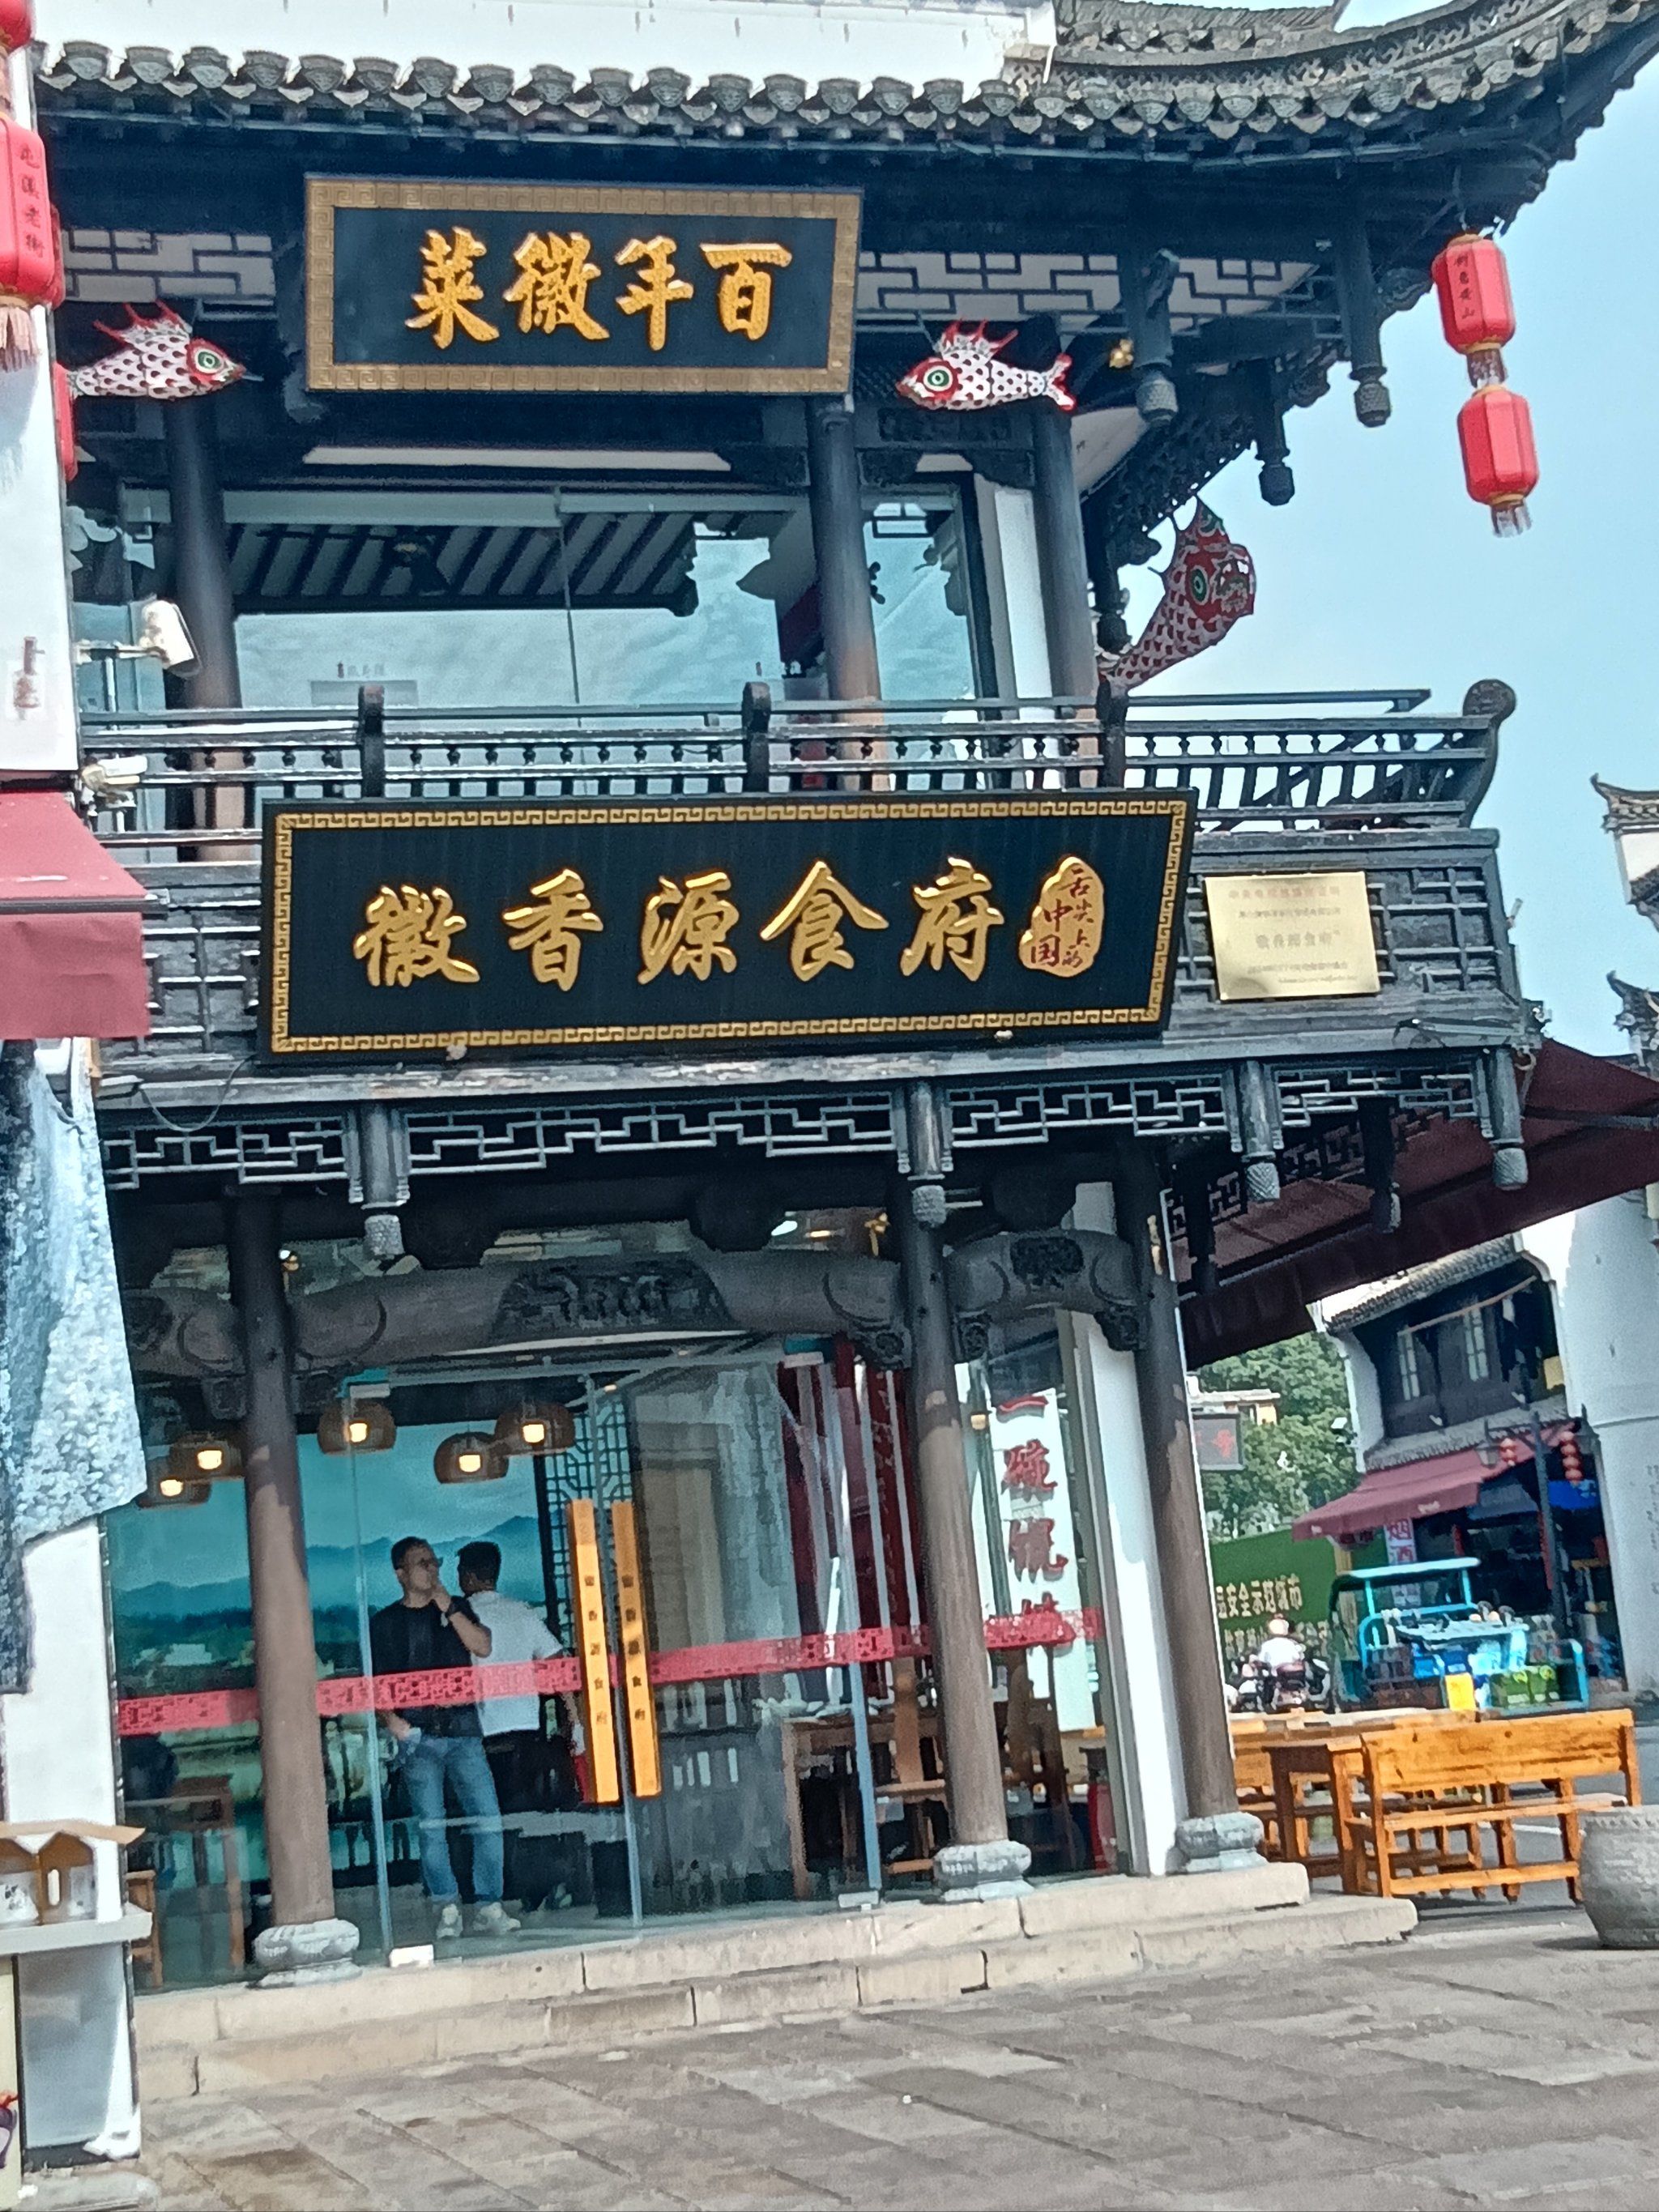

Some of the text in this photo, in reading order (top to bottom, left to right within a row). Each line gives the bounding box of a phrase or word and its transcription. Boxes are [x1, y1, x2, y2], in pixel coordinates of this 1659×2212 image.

[353, 857, 1004, 991] 徽香源食府
[1030, 898, 1074, 967] 中国
